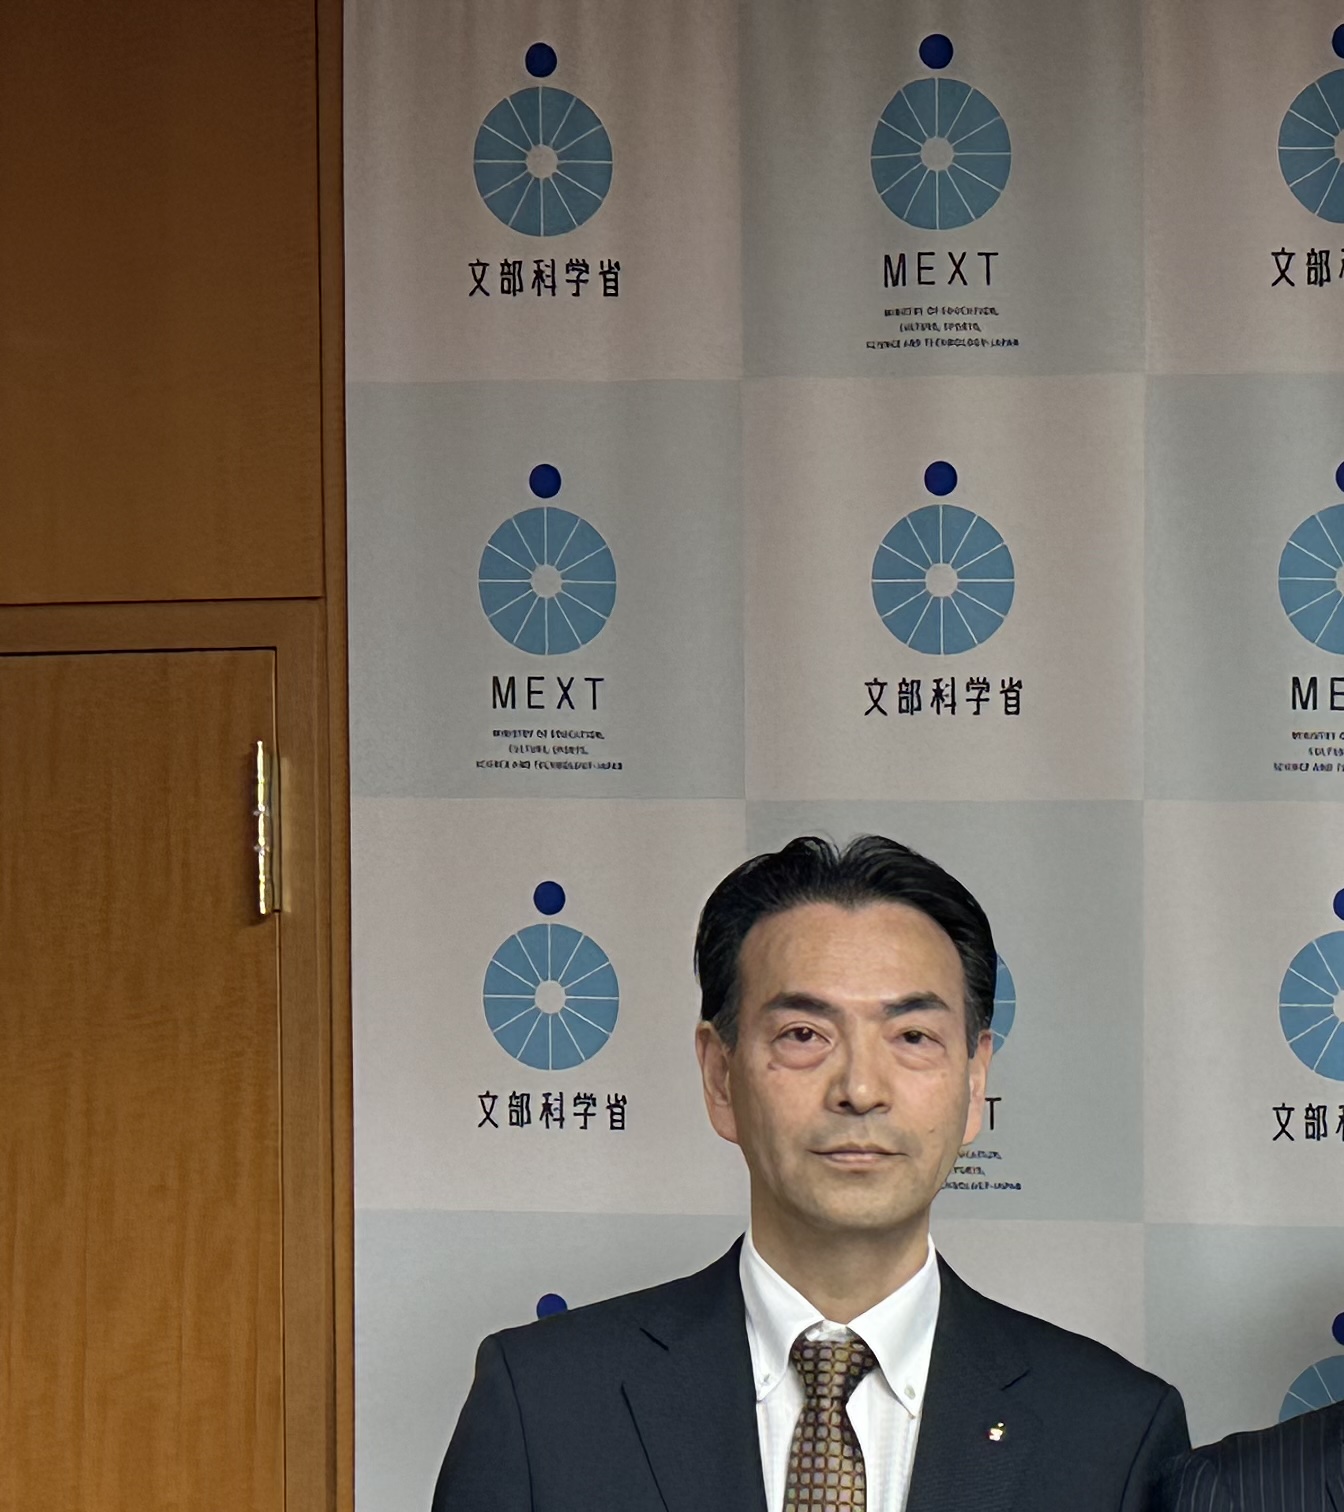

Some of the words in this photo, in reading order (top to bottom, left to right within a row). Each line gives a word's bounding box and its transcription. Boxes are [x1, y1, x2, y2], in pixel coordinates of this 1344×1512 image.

[468, 258, 620, 297] 文部科学省
[884, 252, 999, 288] MEXT
[492, 676, 604, 710] MEXT
[864, 677, 1022, 716] 文部科学省
[478, 1090, 627, 1130] 文部科学省
